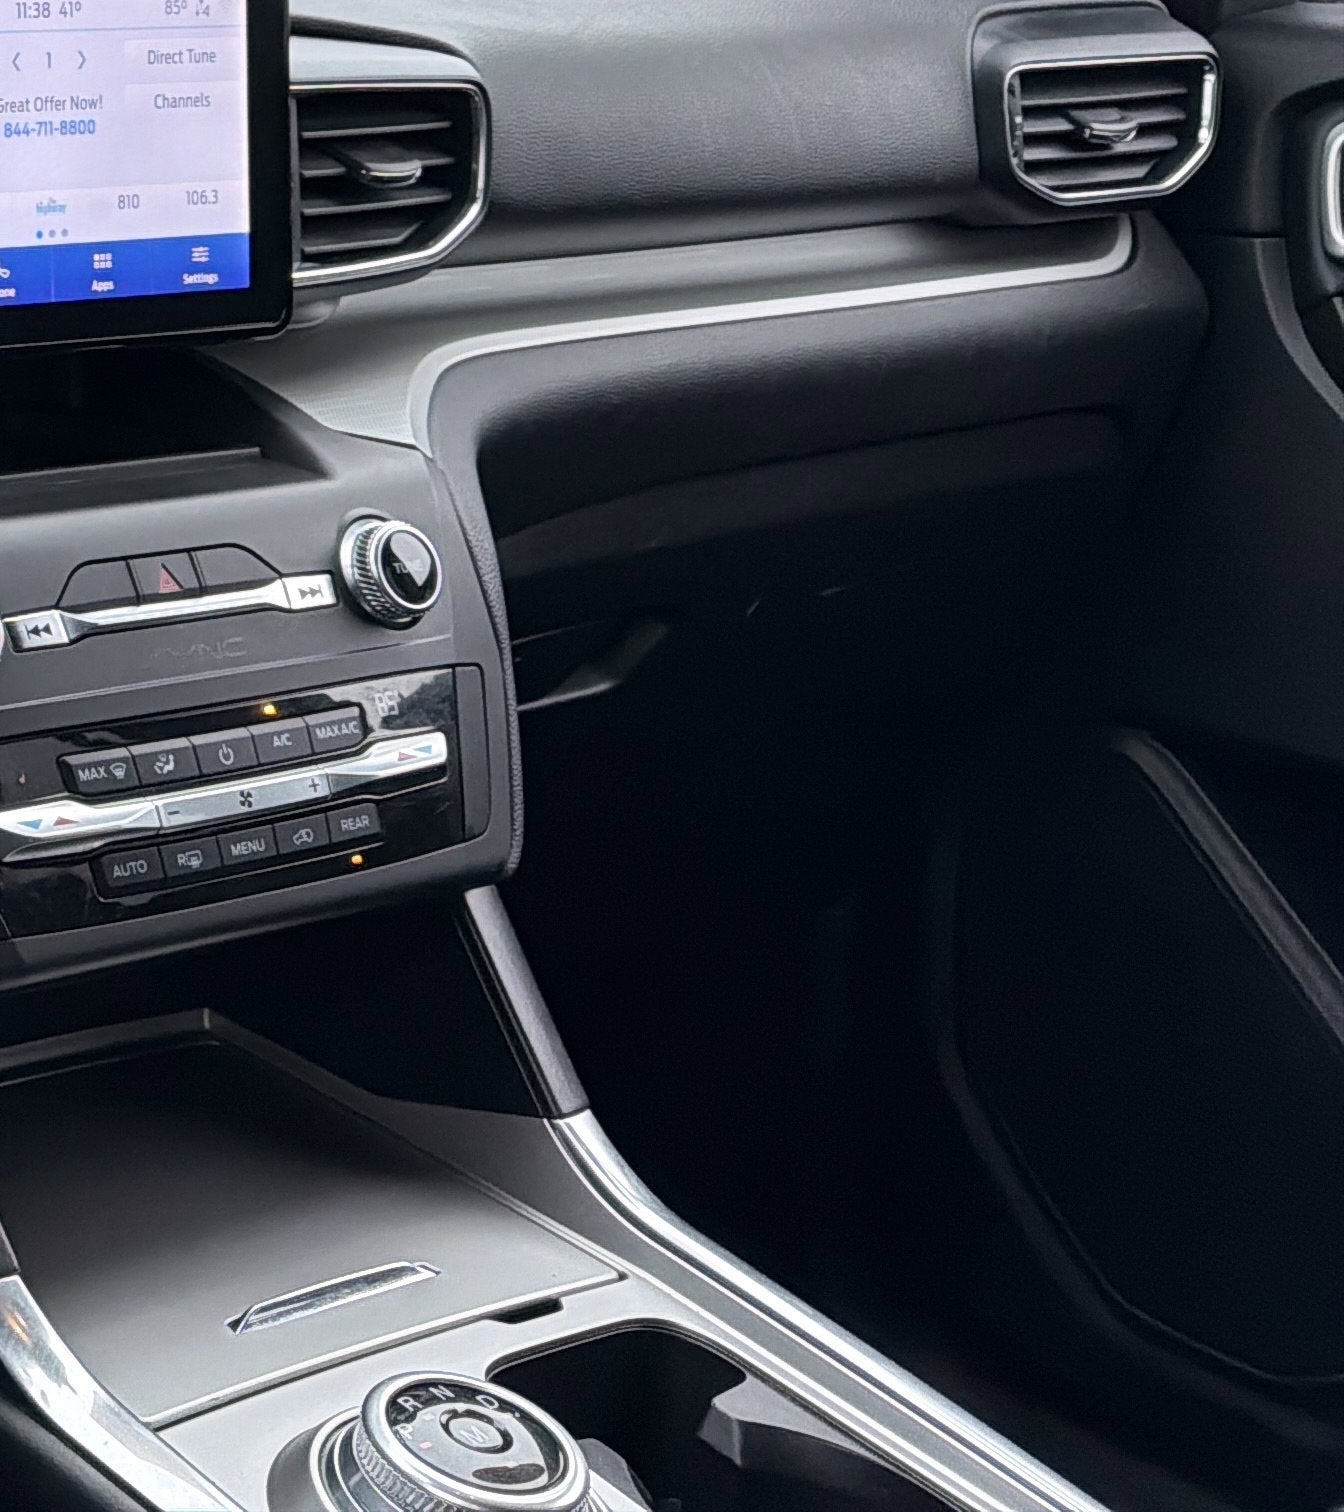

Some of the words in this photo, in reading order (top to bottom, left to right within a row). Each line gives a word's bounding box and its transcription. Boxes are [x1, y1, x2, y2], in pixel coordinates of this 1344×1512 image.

[16, 2, 50, 19] 11:38
[147, 49, 183, 65] Direct
[186, 48, 216, 64] Tune
[34, 96, 66, 112] Offer
[69, 94, 103, 110] Now!
[154, 92, 211, 110] Channels
[4, 119, 96, 138] 844-711-8800
[117, 193, 140, 209] 810
[186, 189, 219, 206] 106.3
[91, 279, 115, 292] Apps
[182, 272, 219, 286] Settings
[315, 724, 341, 740] MAX
[340, 720, 360, 736] A/C
[272, 733, 293, 748] A/C
[78, 765, 108, 782] MAX
[340, 815, 371, 832] REAR
[230, 839, 265, 857] MENU
[112, 859, 148, 878] AUTO
[428, 1384, 456, 1401] N
[396, 1396, 424, 1413] R
[475, 1394, 500, 1410] D
[395, 1422, 414, 1440] P
[460, 1425, 489, 1444] M
